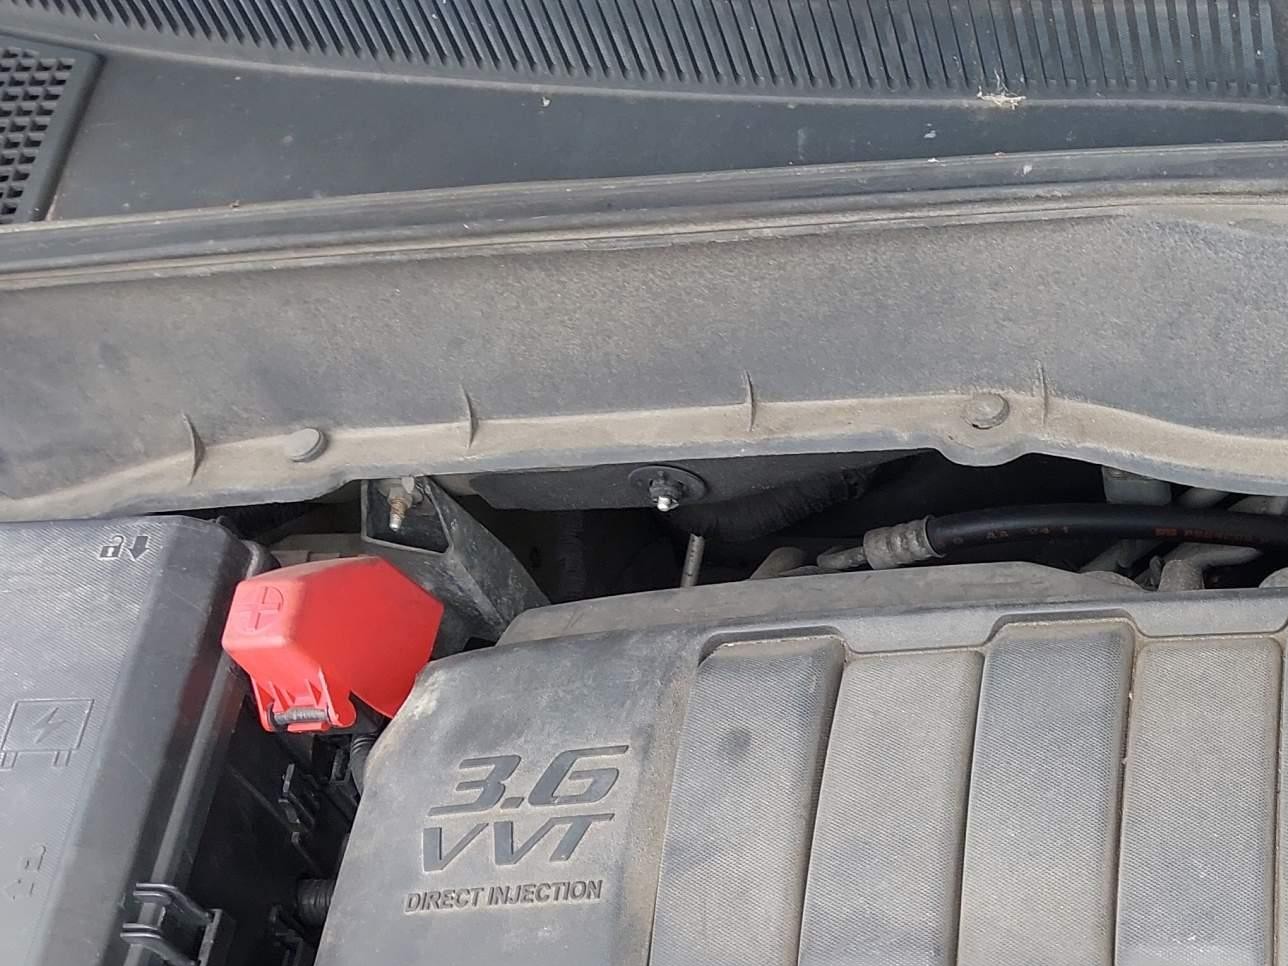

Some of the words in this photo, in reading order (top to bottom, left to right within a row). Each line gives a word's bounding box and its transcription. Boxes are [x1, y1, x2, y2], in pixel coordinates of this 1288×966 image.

[427, 744, 630, 817] 3.6
[421, 812, 616, 873] VVT
[404, 886, 484, 915] DIRECT
[486, 878, 604, 907] INJECTION
